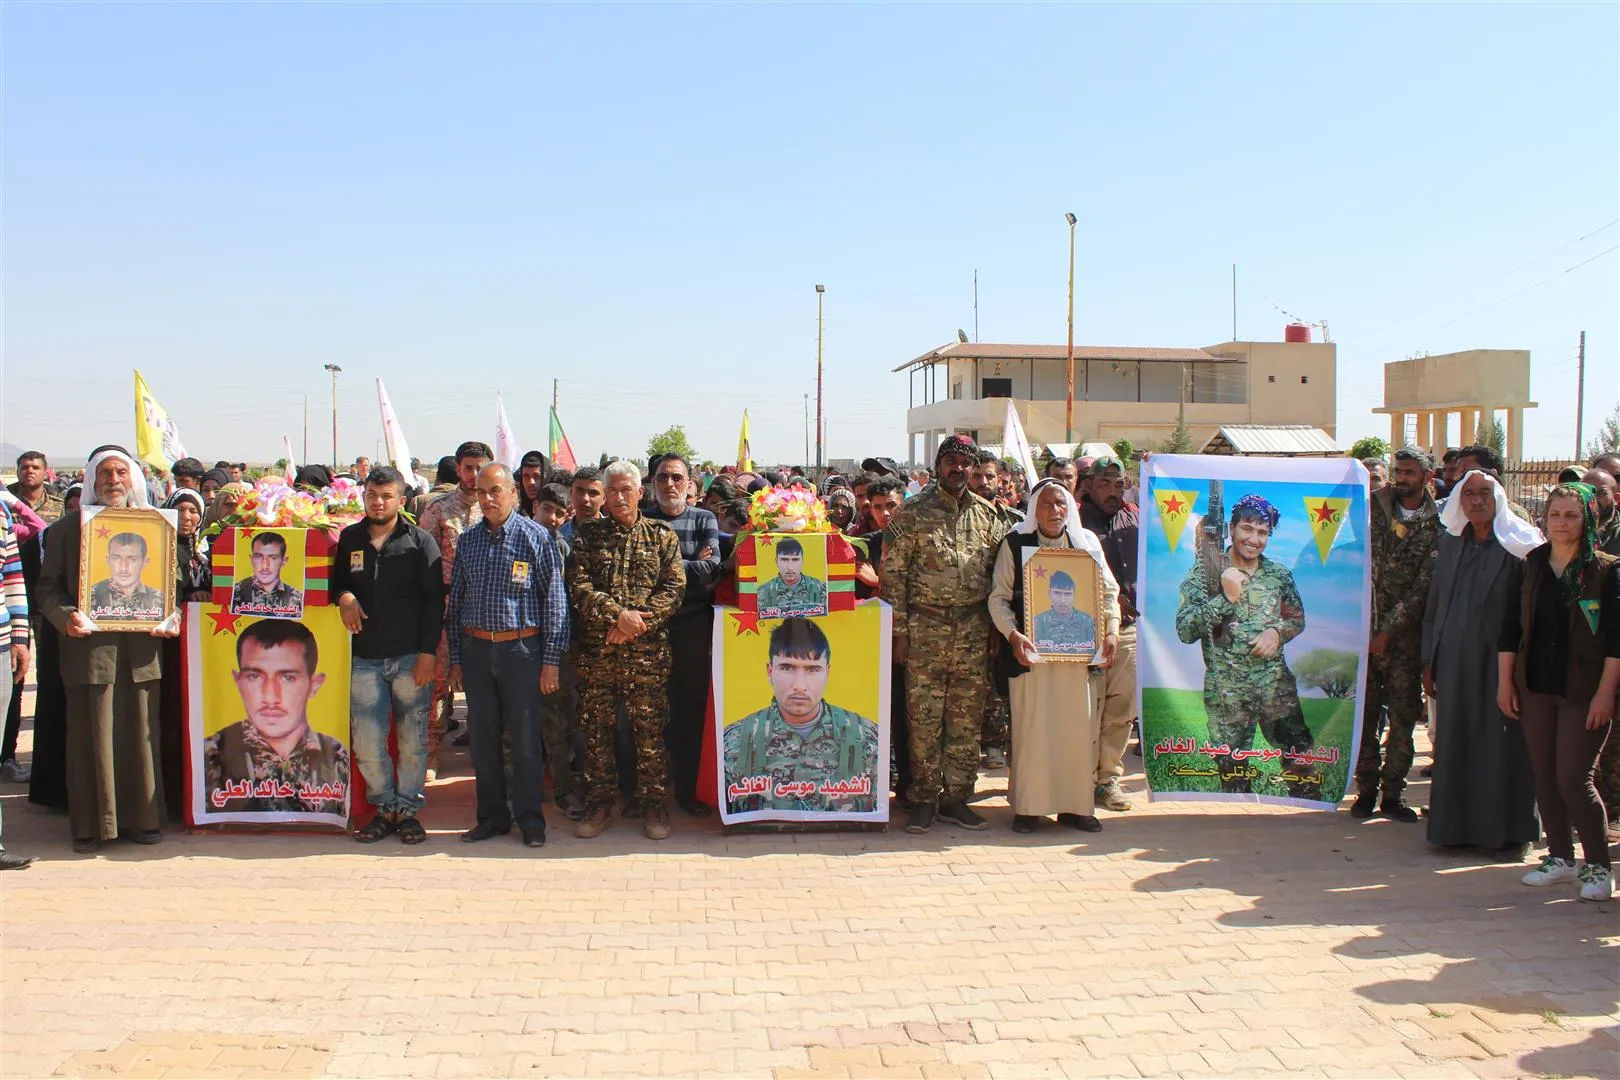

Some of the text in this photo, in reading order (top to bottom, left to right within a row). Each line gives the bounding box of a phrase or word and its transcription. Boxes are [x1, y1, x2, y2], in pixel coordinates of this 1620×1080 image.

[90, 606, 112, 620] العلي
[112, 606, 133, 616] خالد
[253, 603, 272, 613] خالد
[782, 609, 801, 617] موسى
[801, 604, 825, 617] الشهيد
[1054, 641, 1073, 651] موسى
[1153, 736, 1340, 766] الشهيد موسى عبد الغانم
[1168, 763, 1220, 777] حسكة
[211, 778, 346, 808] لشهيد خالد العلي
[728, 775, 871, 803] الشهيد موسى الغانم
